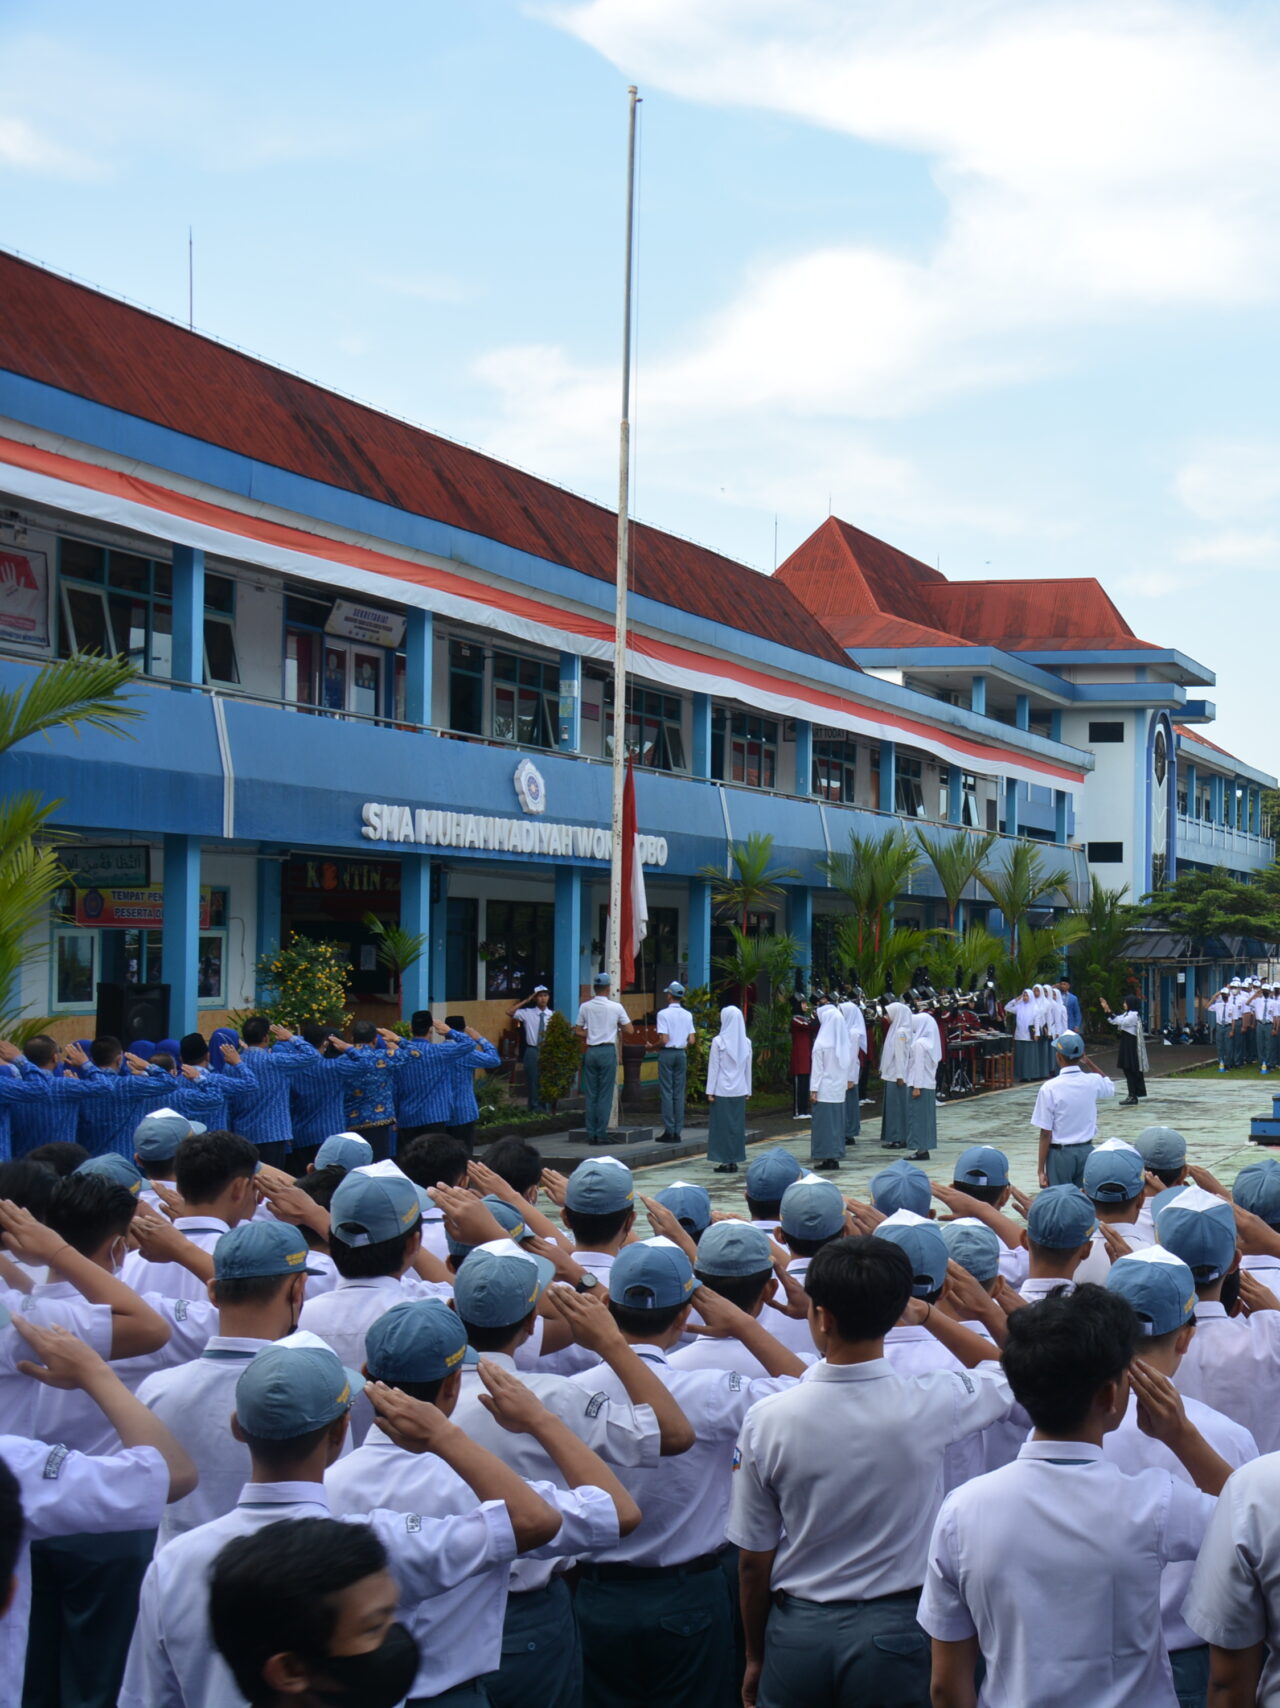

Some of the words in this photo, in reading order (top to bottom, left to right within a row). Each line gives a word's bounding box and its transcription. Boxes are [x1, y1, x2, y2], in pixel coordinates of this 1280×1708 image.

[361, 802, 415, 843] SMA
[414, 809, 573, 857] MUHAMMADIYAH
[111, 890, 145, 900] TEMPAT
[114, 908, 153, 918] PESERTA
